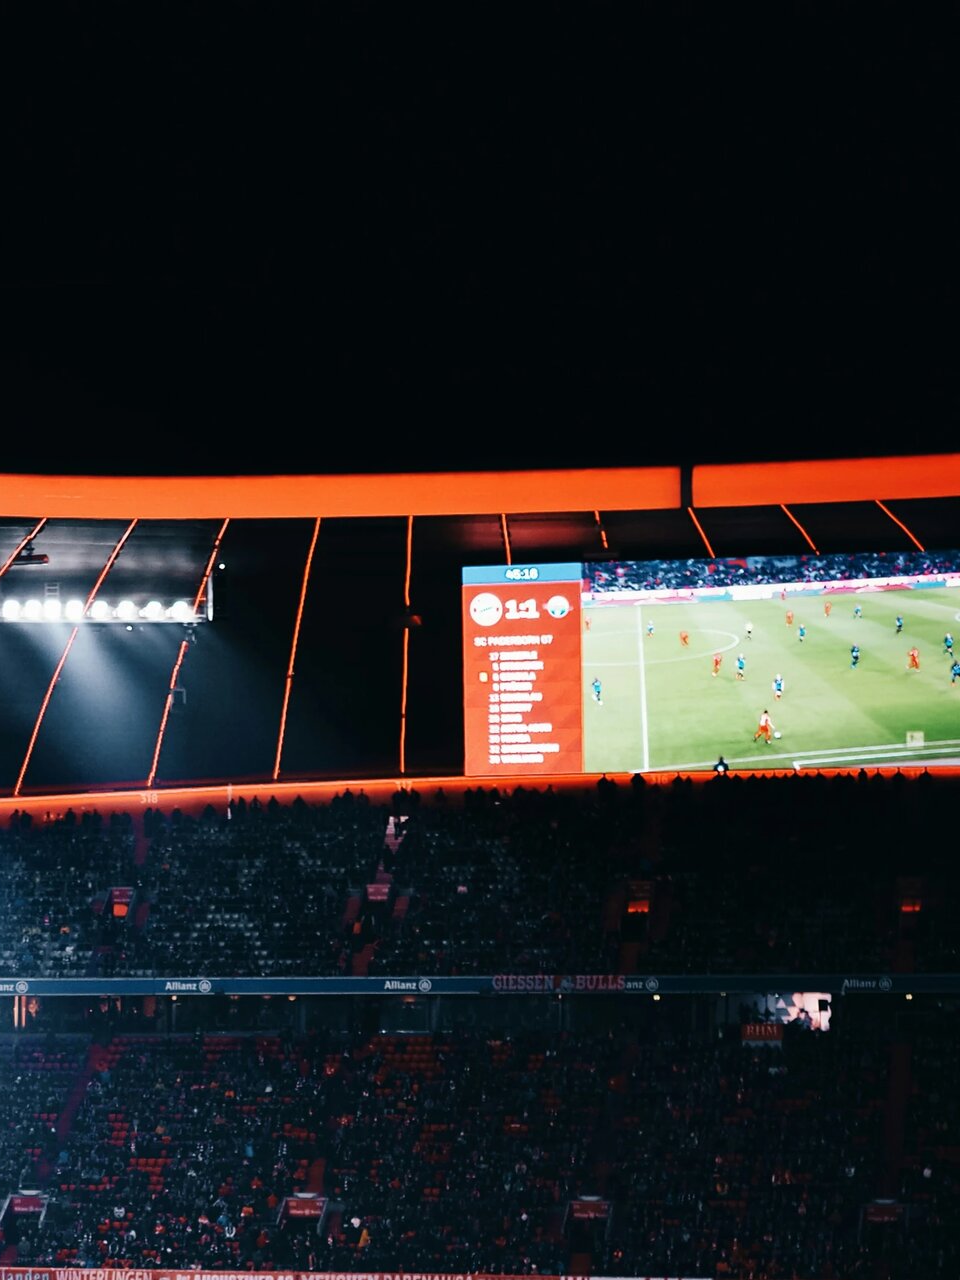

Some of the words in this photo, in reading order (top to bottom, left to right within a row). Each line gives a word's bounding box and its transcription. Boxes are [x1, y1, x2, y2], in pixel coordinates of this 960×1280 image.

[165, 980, 197, 992] Allianz
[384, 980, 416, 992] Allianz
[492, 975, 554, 991] GIESSEN
[575, 975, 626, 991] BULLS
[843, 977, 876, 990] Allianz
